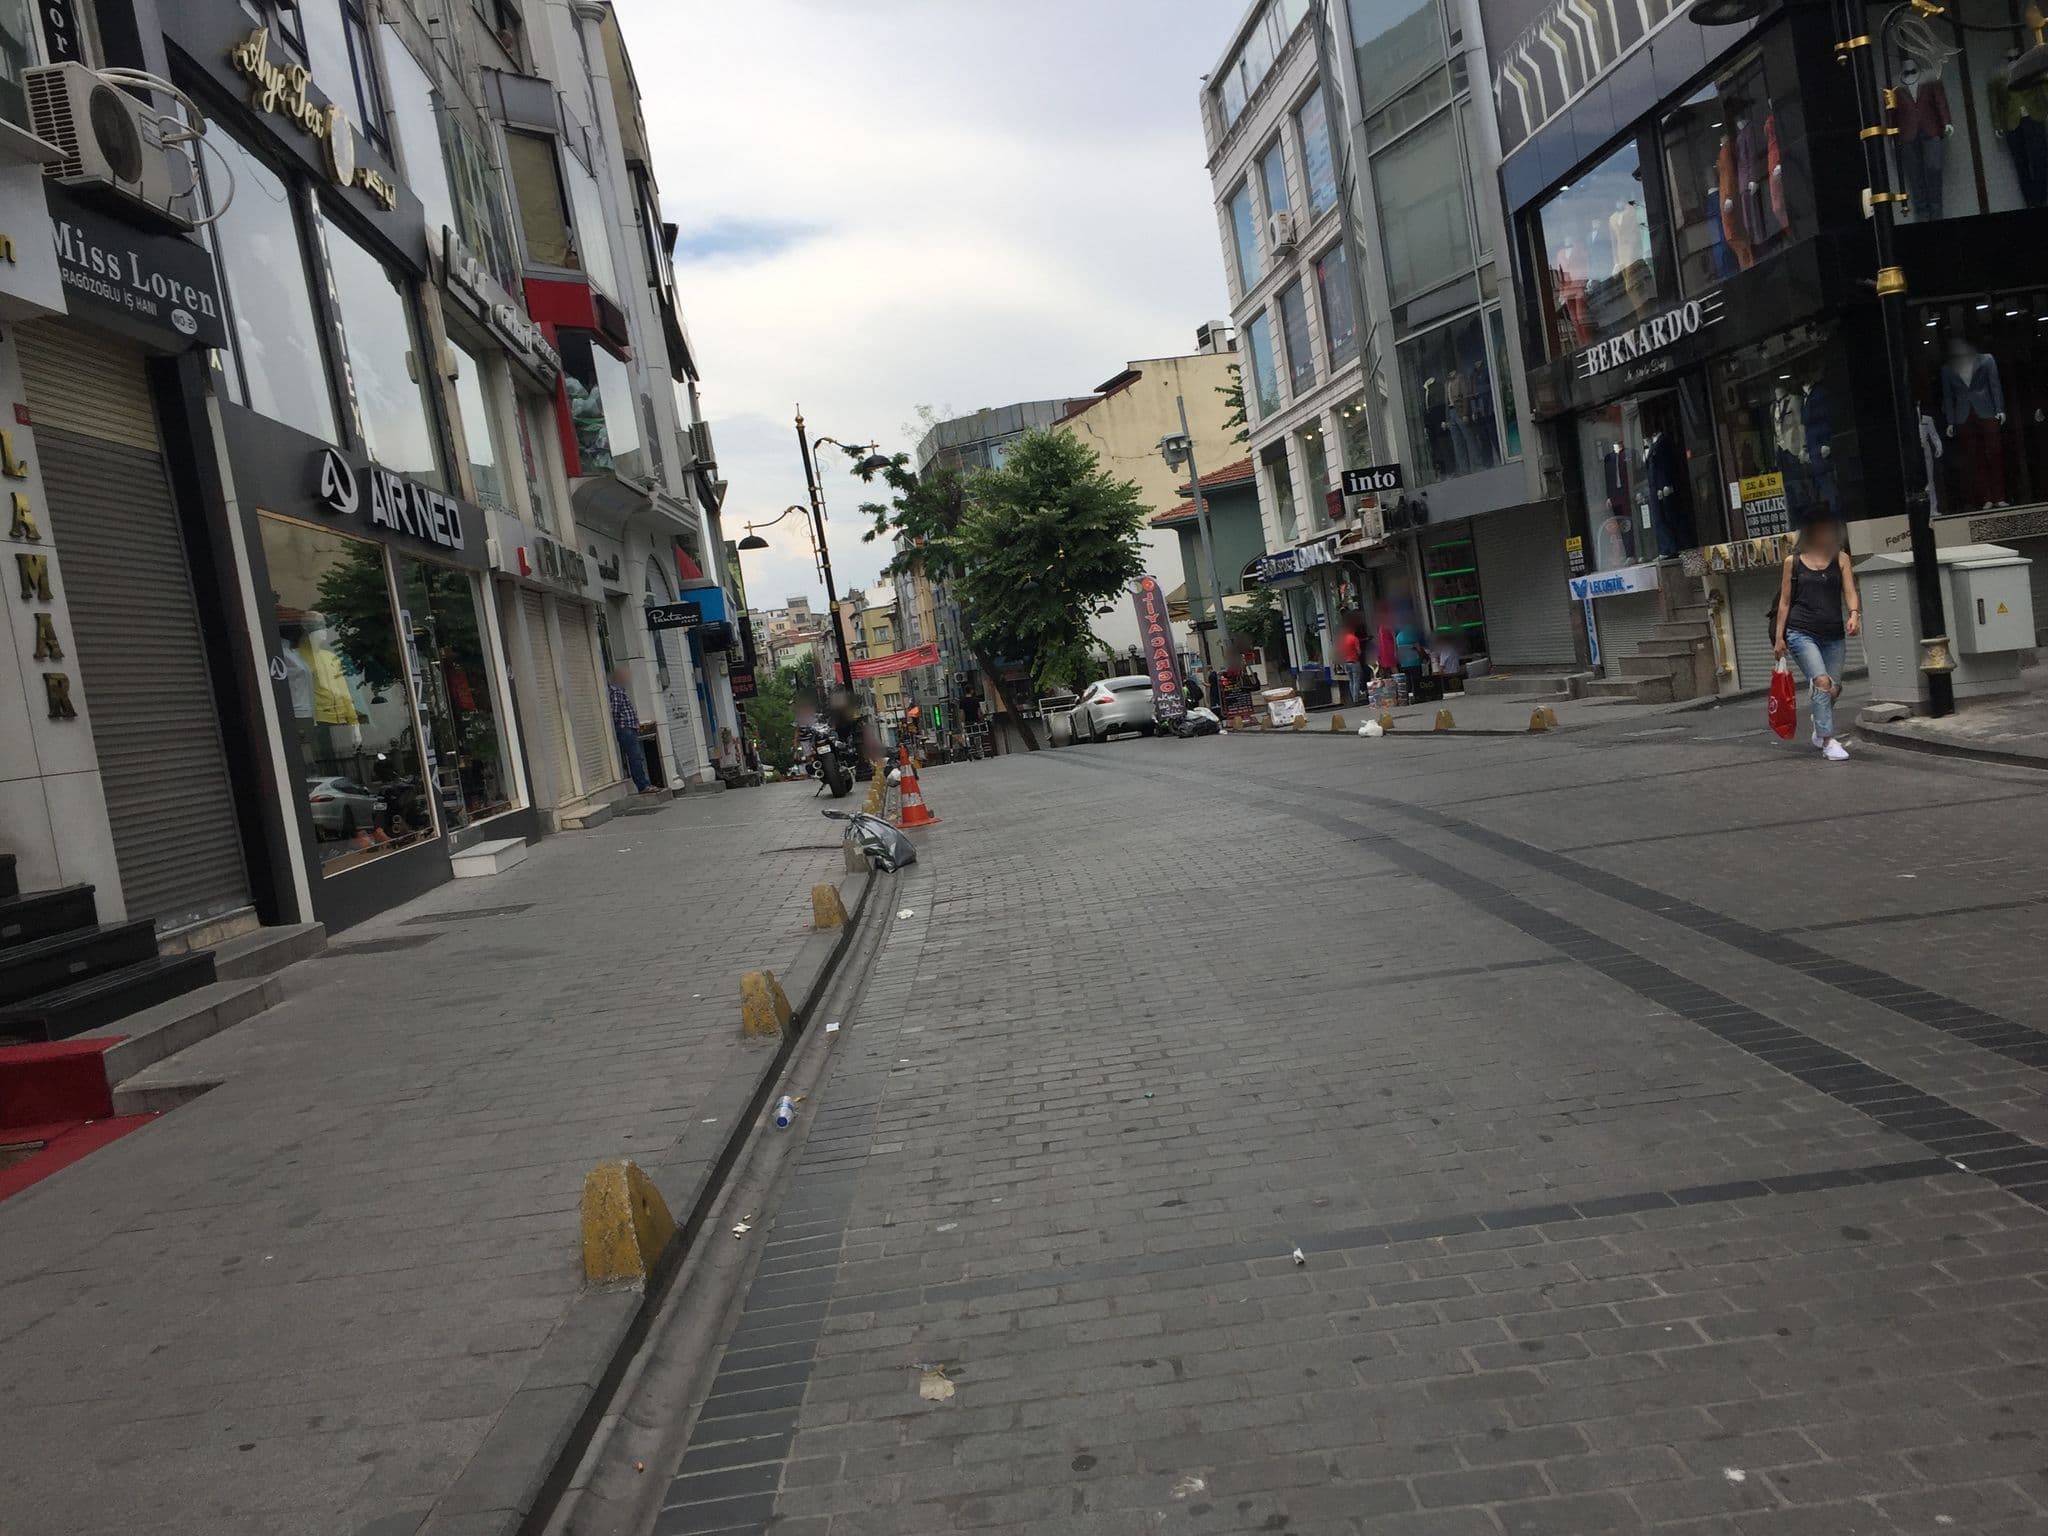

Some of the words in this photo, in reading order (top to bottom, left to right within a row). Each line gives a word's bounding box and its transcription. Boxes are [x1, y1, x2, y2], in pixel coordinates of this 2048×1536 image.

[49, 221, 122, 281] Miss
[127, 251, 217, 319] Loren
[1586, 300, 1701, 376] BERNARDO
[1350, 470, 1396, 493] into
[1744, 496, 1786, 515] SATILIK
